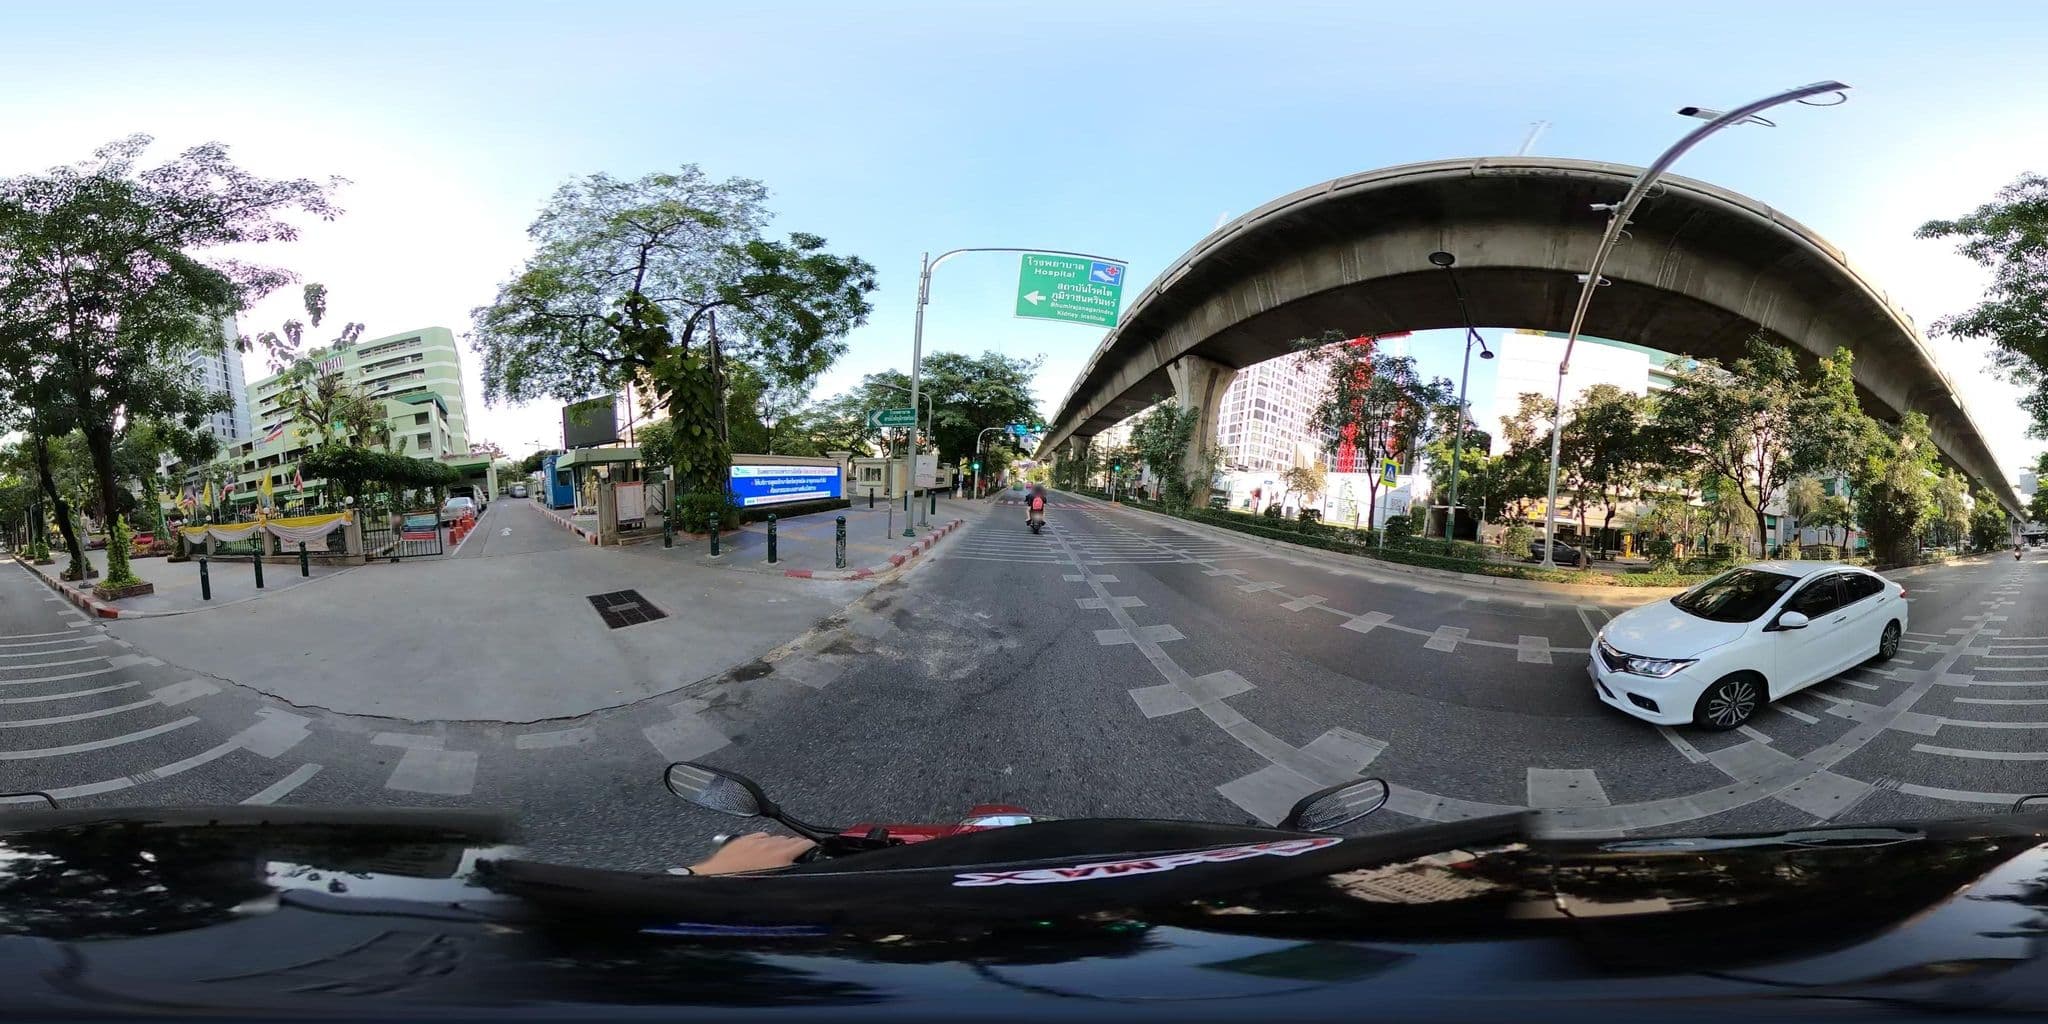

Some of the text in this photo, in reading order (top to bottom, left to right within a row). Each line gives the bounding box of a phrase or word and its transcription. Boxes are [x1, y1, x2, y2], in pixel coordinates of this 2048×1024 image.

[1027, 256, 1085, 271] โรงพยาบาล
[1034, 268, 1075, 278] Hospital
[1056, 310, 1106, 322] Kidney Institute
